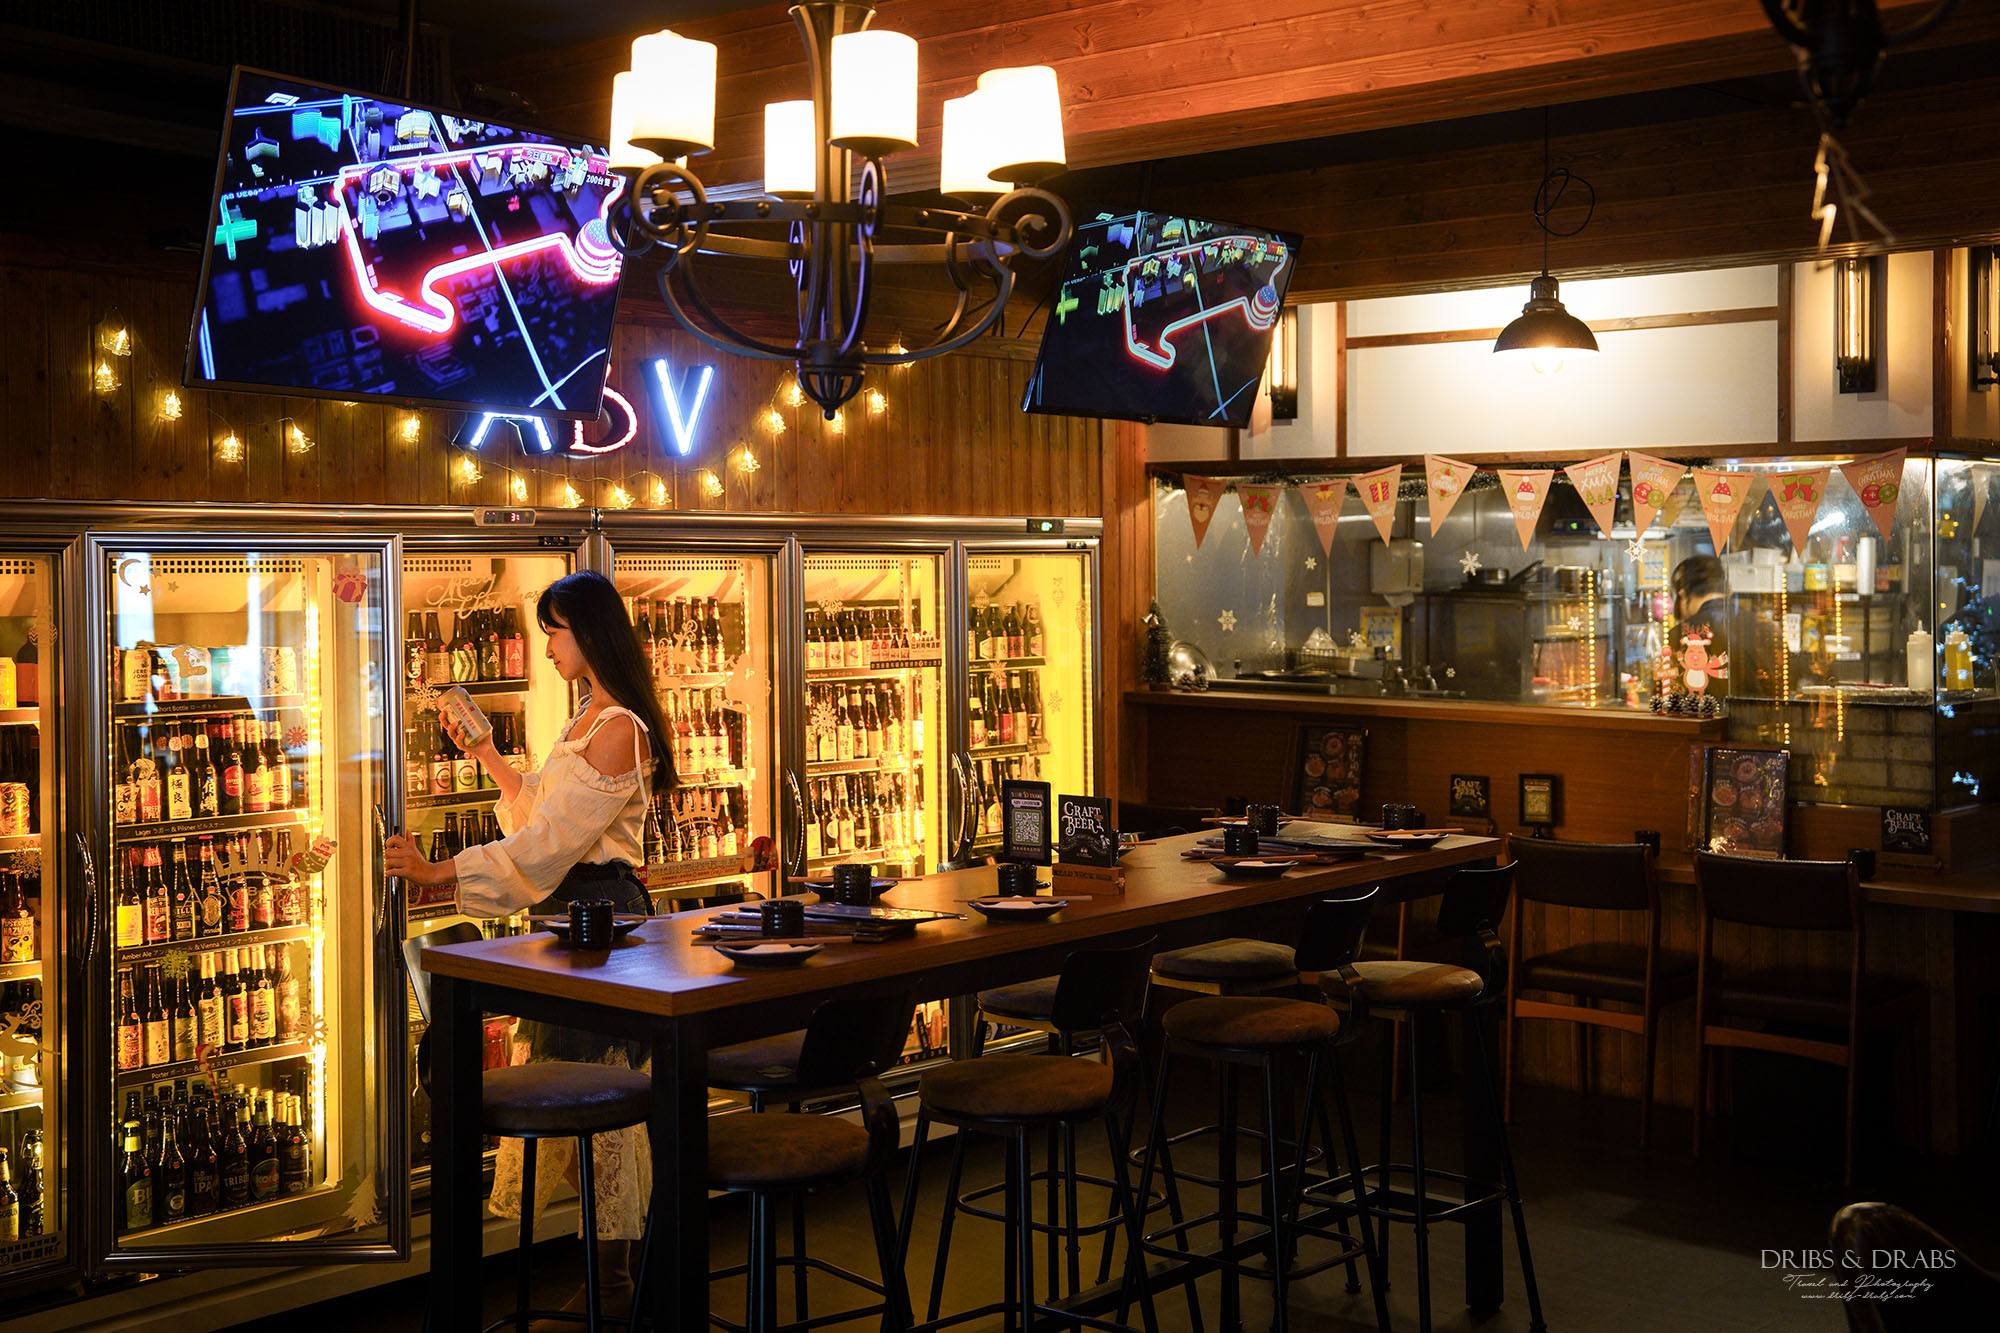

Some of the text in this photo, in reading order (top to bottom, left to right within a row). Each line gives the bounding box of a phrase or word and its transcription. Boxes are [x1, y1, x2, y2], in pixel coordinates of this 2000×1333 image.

[1581, 471, 1616, 491] XMAS
[1857, 470, 1896, 487] CHRISTMAS
[172, 704, 190, 712] Bottle
[1064, 801, 1101, 816] CRAFT
[1886, 808, 1921, 821] CRAFT
[135, 827, 151, 837] Lager
[177, 823, 196, 832] Pilsner
[1061, 815, 1098, 837] BEER
[1884, 819, 1919, 834] BEER
[121, 952, 142, 962] Amber
[142, 950, 153, 958] Ale
[200, 941, 220, 949] Vienna
[151, 1071, 170, 1080] Porter
